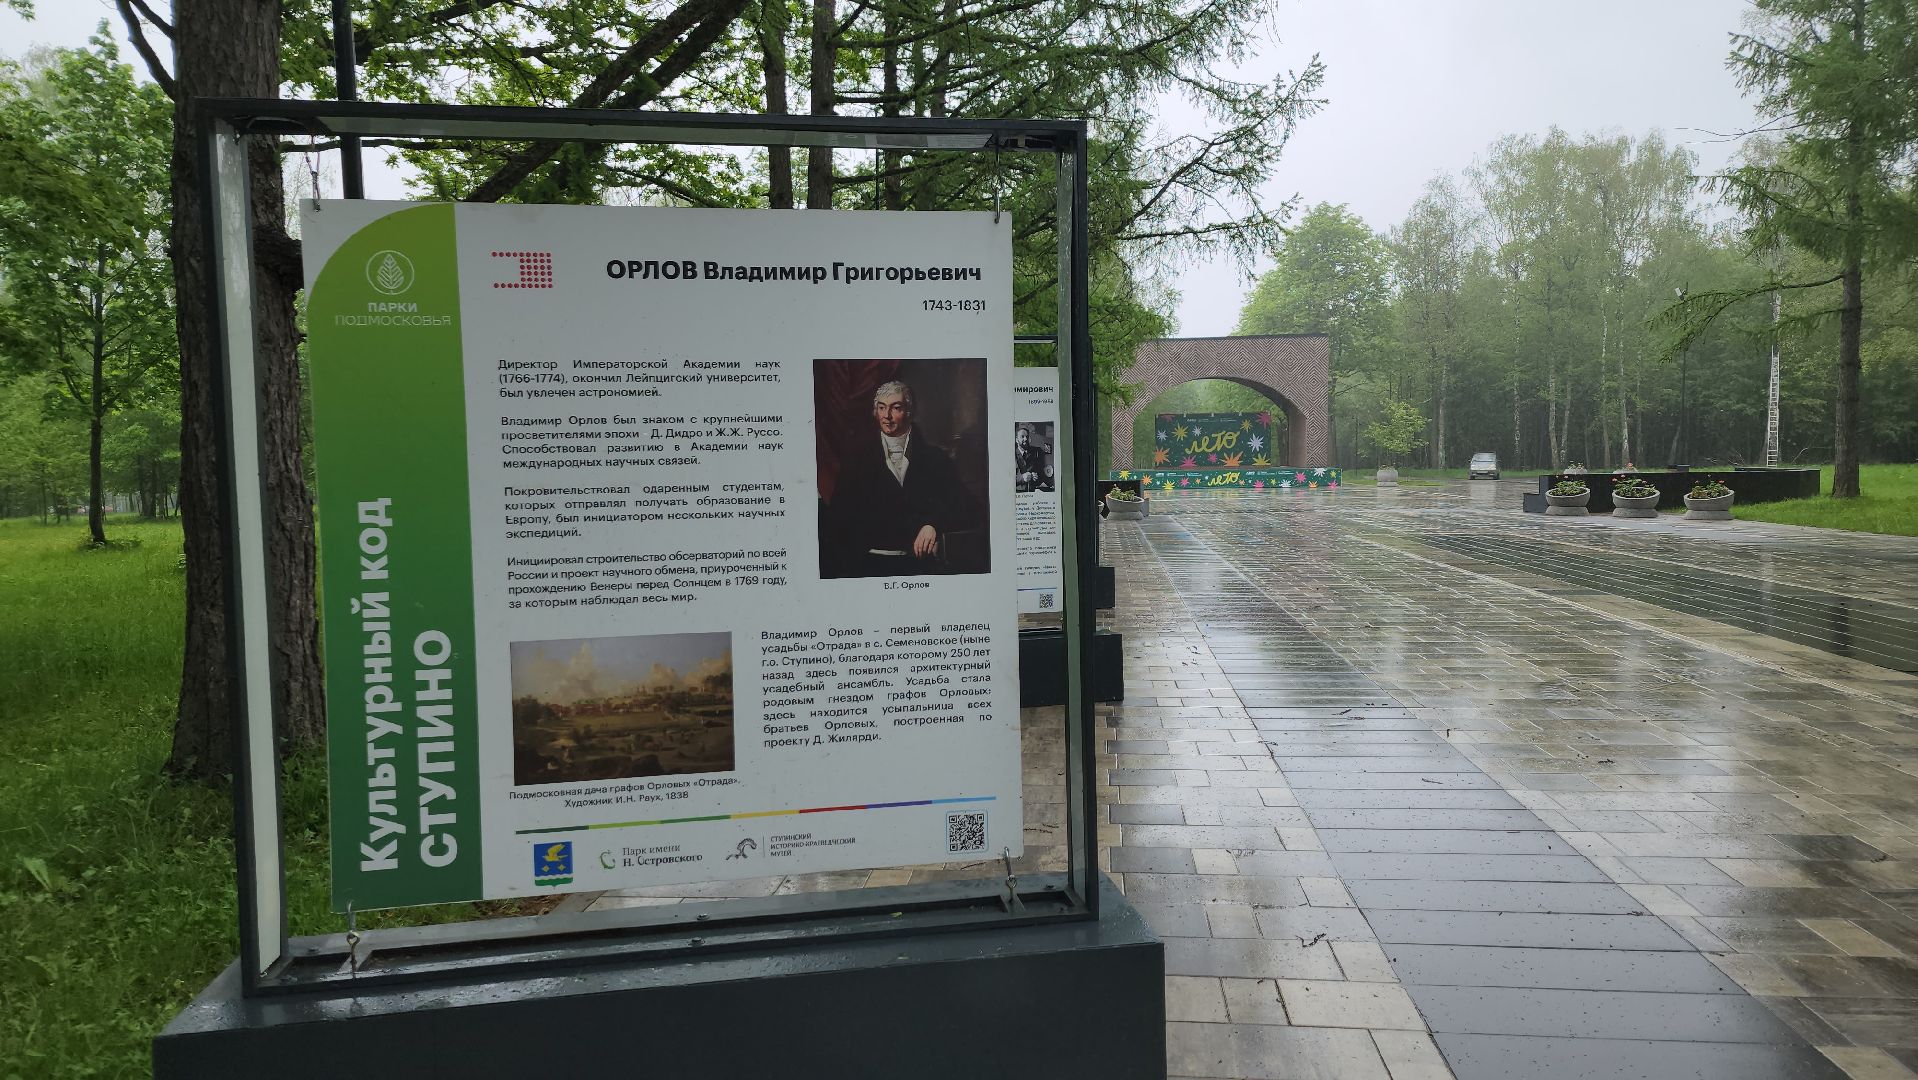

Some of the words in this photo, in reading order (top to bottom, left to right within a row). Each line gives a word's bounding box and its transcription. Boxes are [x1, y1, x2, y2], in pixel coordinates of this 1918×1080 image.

[606, 260, 698, 280] ОРЛОВ
[704, 262, 827, 284] Владимир
[832, 262, 982, 284] Григорьевич
[368, 302, 417, 312] ПАРКИ
[922, 300, 986, 311] 1743-1831
[335, 315, 452, 326] ПОДМОСКОВЬЯ
[498, 360, 558, 371] Директор
[573, 359, 668, 371] Императорской
[683, 360, 741, 369] Академии
[755, 361, 781, 371] наук
[499, 373, 568, 385] (1766-1774),
[572, 375, 621, 383] окончил
[625, 372, 703, 385] Лейпцигский
[707, 373, 781, 384] университет,
[500, 387, 523, 398] был
[527, 389, 576, 398] увлечен
[578, 387, 662, 398] астрономией.
[501, 416, 562, 428] Владимир
[569, 415, 607, 428] Орлов
[613, 414, 636, 425] был
[643, 416, 685, 424] знаком
[703, 413, 783, 426] крупнейшими
[502, 429, 602, 441] просветителями
[605, 430, 639, 440] эпохи
[651, 429, 663, 439] Д.
[666, 429, 703, 439] Дидро
[715, 428, 744, 437] Ж.Ж.
[747, 427, 783, 438] Руссо.
[502, 443, 596, 455] Способствовал
[691, 442, 748, 451] Академии
[758, 442, 784, 452] наук
[503, 457, 602, 469] международных
[605, 457, 655, 469] научных
[504, 485, 630, 497] Покровительствовал
[643, 484, 710, 495] одаренным
[722, 482, 785, 493] студентам,
[505, 501, 555, 511] которых
[564, 500, 626, 510] отправлял
[635, 499, 688, 509] получать
[697, 496, 771, 507] образование
[779, 496, 785, 504] в
[505, 514, 551, 525] Европу,
[556, 512, 579, 523] был
[584, 512, 663, 523] инициатором
[667, 510, 734, 520] нескольких
[738, 509, 786, 519] научных
[357, 497, 393, 580] код
[506, 527, 581, 539] экспедиций.
[508, 555, 584, 568] Инициировал
[586, 552, 666, 565] строительство
[669, 549, 745, 562] обсерваторий
[762, 548, 787, 557] всей
[508, 569, 548, 581] России
[551, 570, 558, 578] и
[561, 569, 599, 580] проект
[602, 567, 652, 578] научного
[654, 564, 698, 576] обмена,
[700, 561, 778, 575] приуроченный
[781, 562, 787, 570] к
[508, 583, 586, 596] прохождению
[591, 581, 633, 592] Венеры
[637, 580, 669, 591] перед
[673, 577, 722, 589] Солнцем
[725, 578, 731, 586] в
[734, 576, 759, 585] 1769
[509, 599, 522, 608] за
[525, 597, 577, 609] которым
[581, 594, 639, 606] наблюдал
[642, 594, 668, 603] весь
[761, 630, 817, 641] Владимир
[828, 628, 863, 638] Орлов
[890, 624, 930, 636] первый
[941, 622, 990, 632] владелец
[762, 643, 808, 655] усадьбы
[811, 641, 862, 651] «Отрада»
[885, 636, 957, 647] Семеновское
[960, 634, 990, 645] (ныне
[762, 658, 779, 667] г.о.
[781, 655, 836, 667] Ступино),
[838, 652, 895, 663] благодаря
[897, 649, 948, 661] которому
[951, 648, 971, 657] 250
[973, 648, 990, 657] лет
[762, 670, 795, 681] назад
[806, 668, 837, 678] здесь
[849, 666, 899, 675] появился
[910, 660, 991, 673] архитектурный
[763, 681, 825, 694] усадебный
[906, 675, 949, 686] Усадьба
[962, 674, 991, 683] стала
[763, 696, 814, 708] родовым
[828, 693, 874, 704] гнездом
[887, 689, 926, 701] графов
[763, 711, 796, 721] здесь
[810, 707, 868, 718] находится
[967, 701, 992, 709] всех
[350, 591, 406, 872] Культурный
[763, 723, 809, 735] братьев
[894, 714, 964, 727] построенная
[979, 714, 992, 722] по
[413, 629, 458, 868] СТУПИНО
[764, 736, 810, 749] проекту
[813, 734, 825, 745] Д.
[509, 788, 582, 799] Подмосковная
[584, 786, 607, 795] дача
[610, 784, 645, 794] графов
[647, 780, 691, 791] Орловых
[564, 796, 613, 808] Художник
[616, 795, 635, 804] И.Н.
[639, 793, 664, 802] Раух,
[666, 791, 689, 799] 1838
[622, 847, 647, 856] Парк
[650, 844, 681, 853] имени
[623, 857, 635, 867] Н.
[638, 853, 703, 867] Островского
